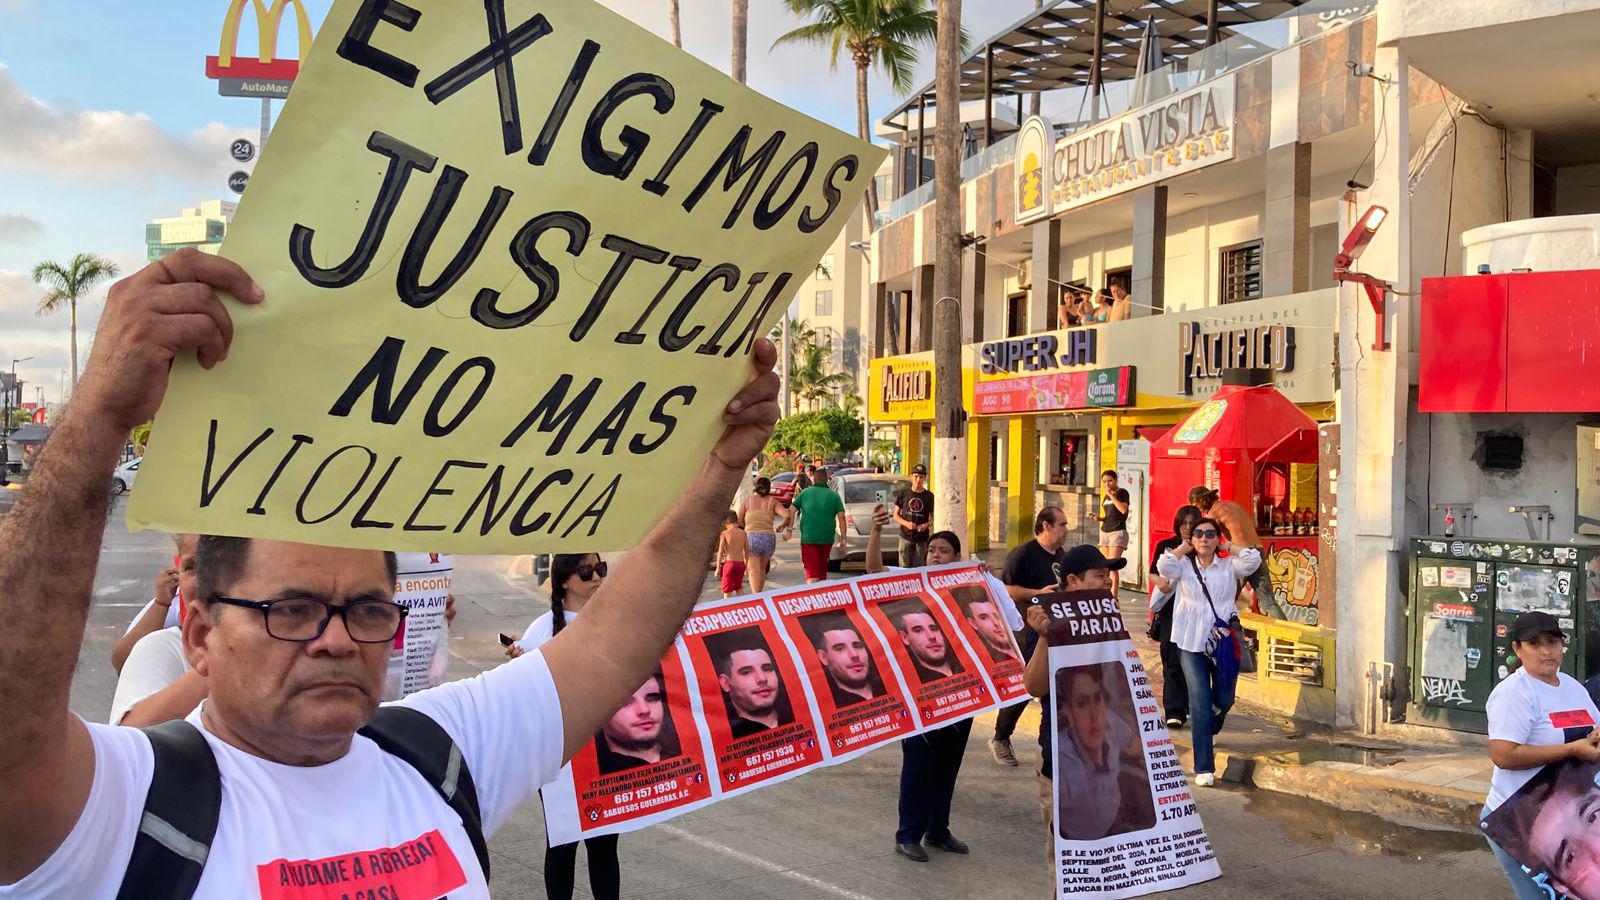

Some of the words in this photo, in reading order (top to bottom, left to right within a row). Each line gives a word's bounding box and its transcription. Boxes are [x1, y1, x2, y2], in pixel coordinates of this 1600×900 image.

[241, 82, 288, 93] AutoMac
[337, 0, 860, 233] EXIGIMOS
[1053, 122, 1130, 185] CHULA
[1138, 87, 1222, 155] VISTA
[1186, 132, 1229, 161] BAR
[234, 143, 249, 154] 24
[981, 334, 1058, 374] SUPER
[1060, 328, 1097, 367] JH
[1178, 321, 1294, 395] PACIFICO
[328, 336, 496, 438] NO
[501, 373, 697, 456] MAS
[200, 419, 622, 539] VIOLENCIA
[862, 578, 923, 600] DESAPARECIDO
[778, 589, 853, 616] DESAPARECIDO
[1050, 602, 1076, 619] SE
[684, 605, 767, 636] DESAPARECIDO
[1069, 617, 1121, 636] PARAD
[1143, 720, 1155, 732] 27
[745, 755, 762, 767] 667
[761, 750, 776, 762] 157
[774, 744, 795, 758] 1930
[1149, 749, 1168, 759] TIENE
[1151, 762, 1161, 770] EN
[1162, 761, 1170, 769] EL
[613, 791, 634, 805] 667
[635, 786, 652, 799] 157
[653, 780, 678, 794] 1930
[1155, 781, 1180, 792] LETRAS
[602, 802, 639, 818] SABUESOS
[1161, 807, 1183, 821] 1.70
[1061, 857, 1110, 866] SEPTIEMBRE
[1113, 854, 1126, 864] DEL
[1158, 844, 1172, 853] LAS
[1187, 840, 1195, 848] PM
[1075, 849, 1086, 857] LE
[1090, 849, 1103, 857] VIO
[1104, 846, 1115, 855] POR
[1145, 838, 1160, 847] VEZ
[353, 855, 366, 881] A
[1063, 876, 1101, 885] PLAYERA
[1103, 873, 1129, 884] NEGRA,
[1130, 868, 1154, 878] SHORT
[1155, 863, 1175, 873] AZUL
[1176, 858, 1194, 868] CLARO
[1101, 863, 1126, 874] DECIMA
[1134, 855, 1167, 867] COLONIA
[1063, 885, 1102, 894] BLANCAS
[1104, 884, 1115, 892] EN
[1157, 870, 1187, 882] SINALOA
